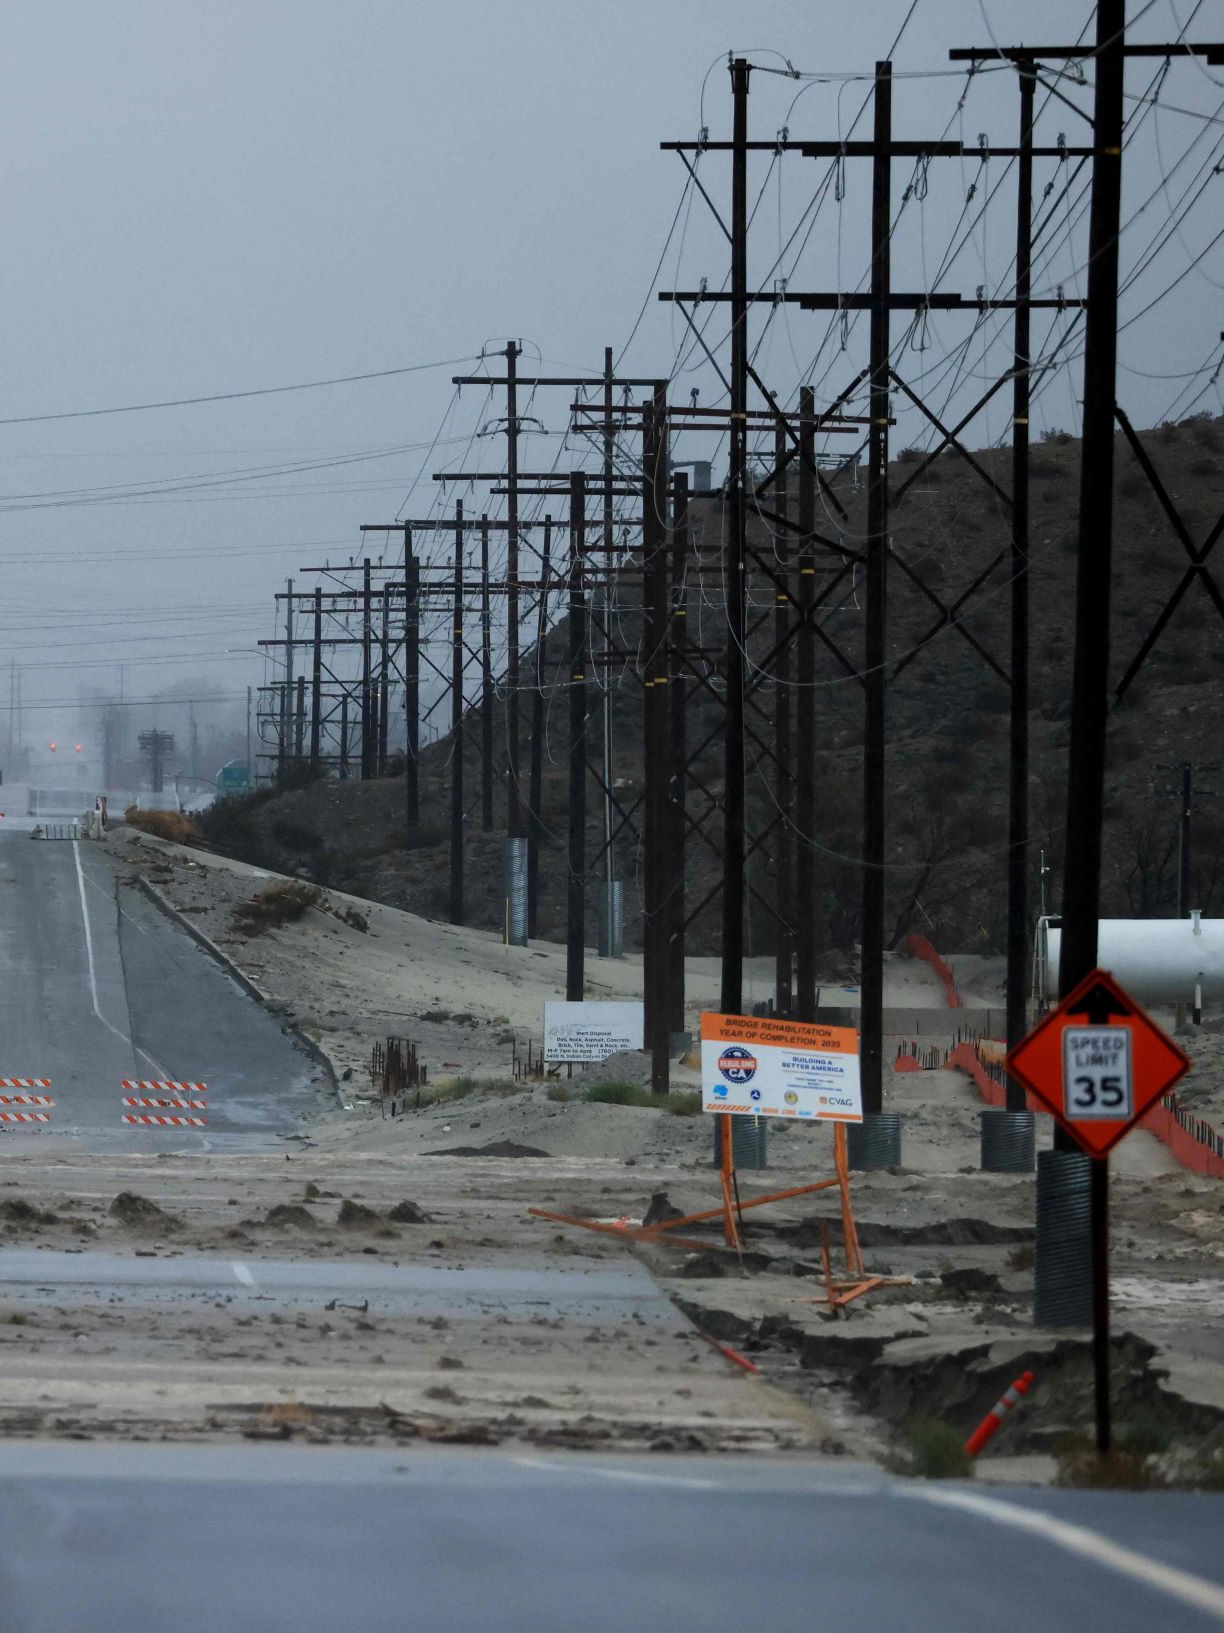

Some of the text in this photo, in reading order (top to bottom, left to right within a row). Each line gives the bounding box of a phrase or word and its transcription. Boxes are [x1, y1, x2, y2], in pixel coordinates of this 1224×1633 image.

[725, 1018, 832, 1037] BRIDGE REHABILITATION
[720, 1029, 743, 1038] YEAR
[746, 1031, 757, 1039] OF
[1070, 1036, 1124, 1050] SPEED
[719, 1059, 756, 1068] REBUILDING
[792, 1056, 826, 1065] BUILDING
[1075, 1053, 1118, 1067] LIMIT
[781, 1062, 844, 1073] BETTER AMERICA
[728, 1069, 747, 1079] CA
[1074, 1076, 1125, 1107] 35
[828, 1098, 853, 1107] CVAG
